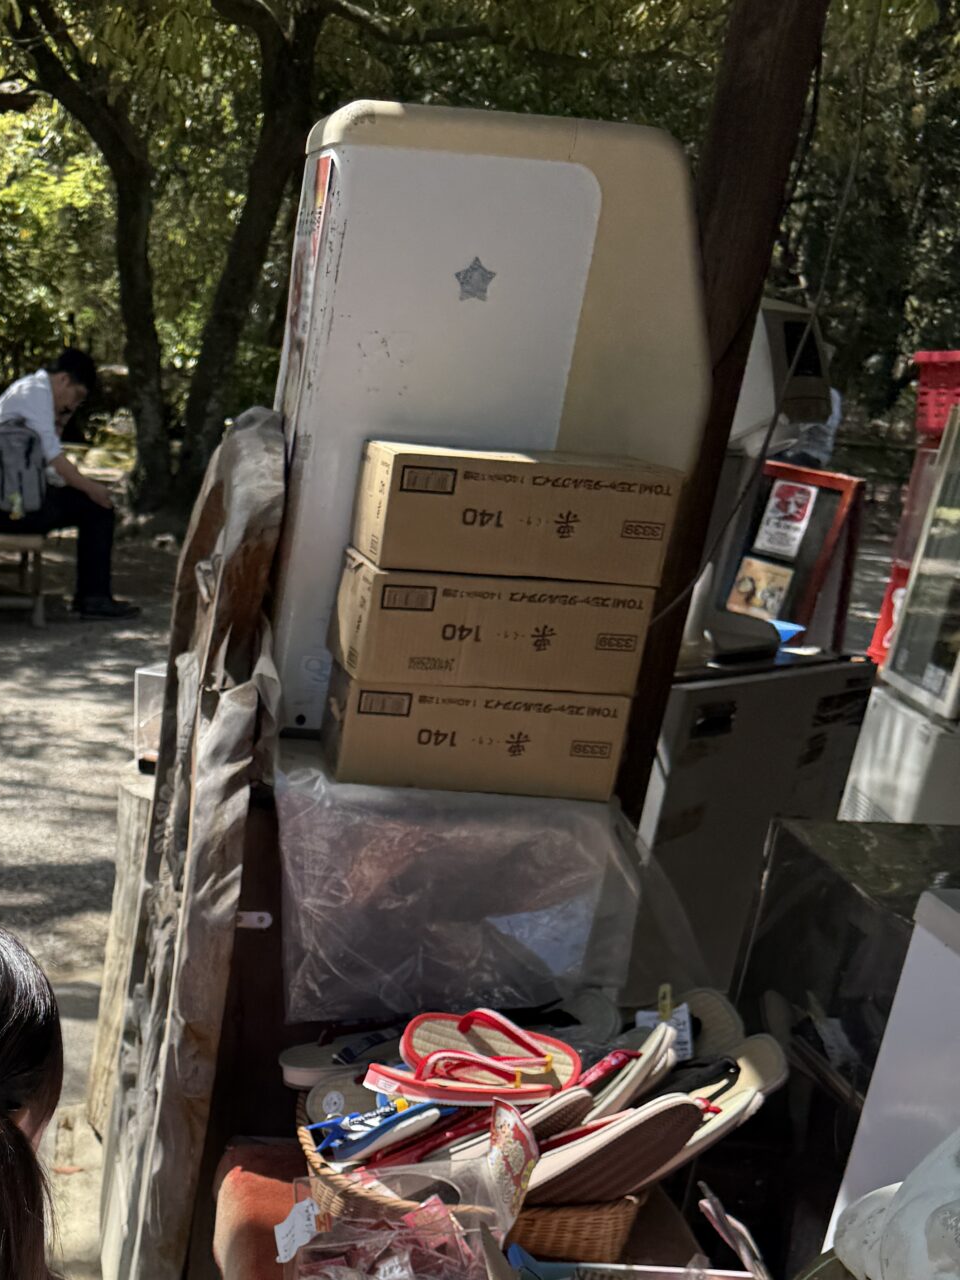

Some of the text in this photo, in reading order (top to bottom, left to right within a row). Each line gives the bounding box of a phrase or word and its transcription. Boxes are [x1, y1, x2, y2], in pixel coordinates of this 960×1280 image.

[461, 507, 504, 529] 140
[554, 509, 581, 540] 栗
[441, 623, 483, 643] 140
[530, 624, 557, 653] 栗
[416, 727, 458, 748] 140
[505, 731, 532, 758] 栗
